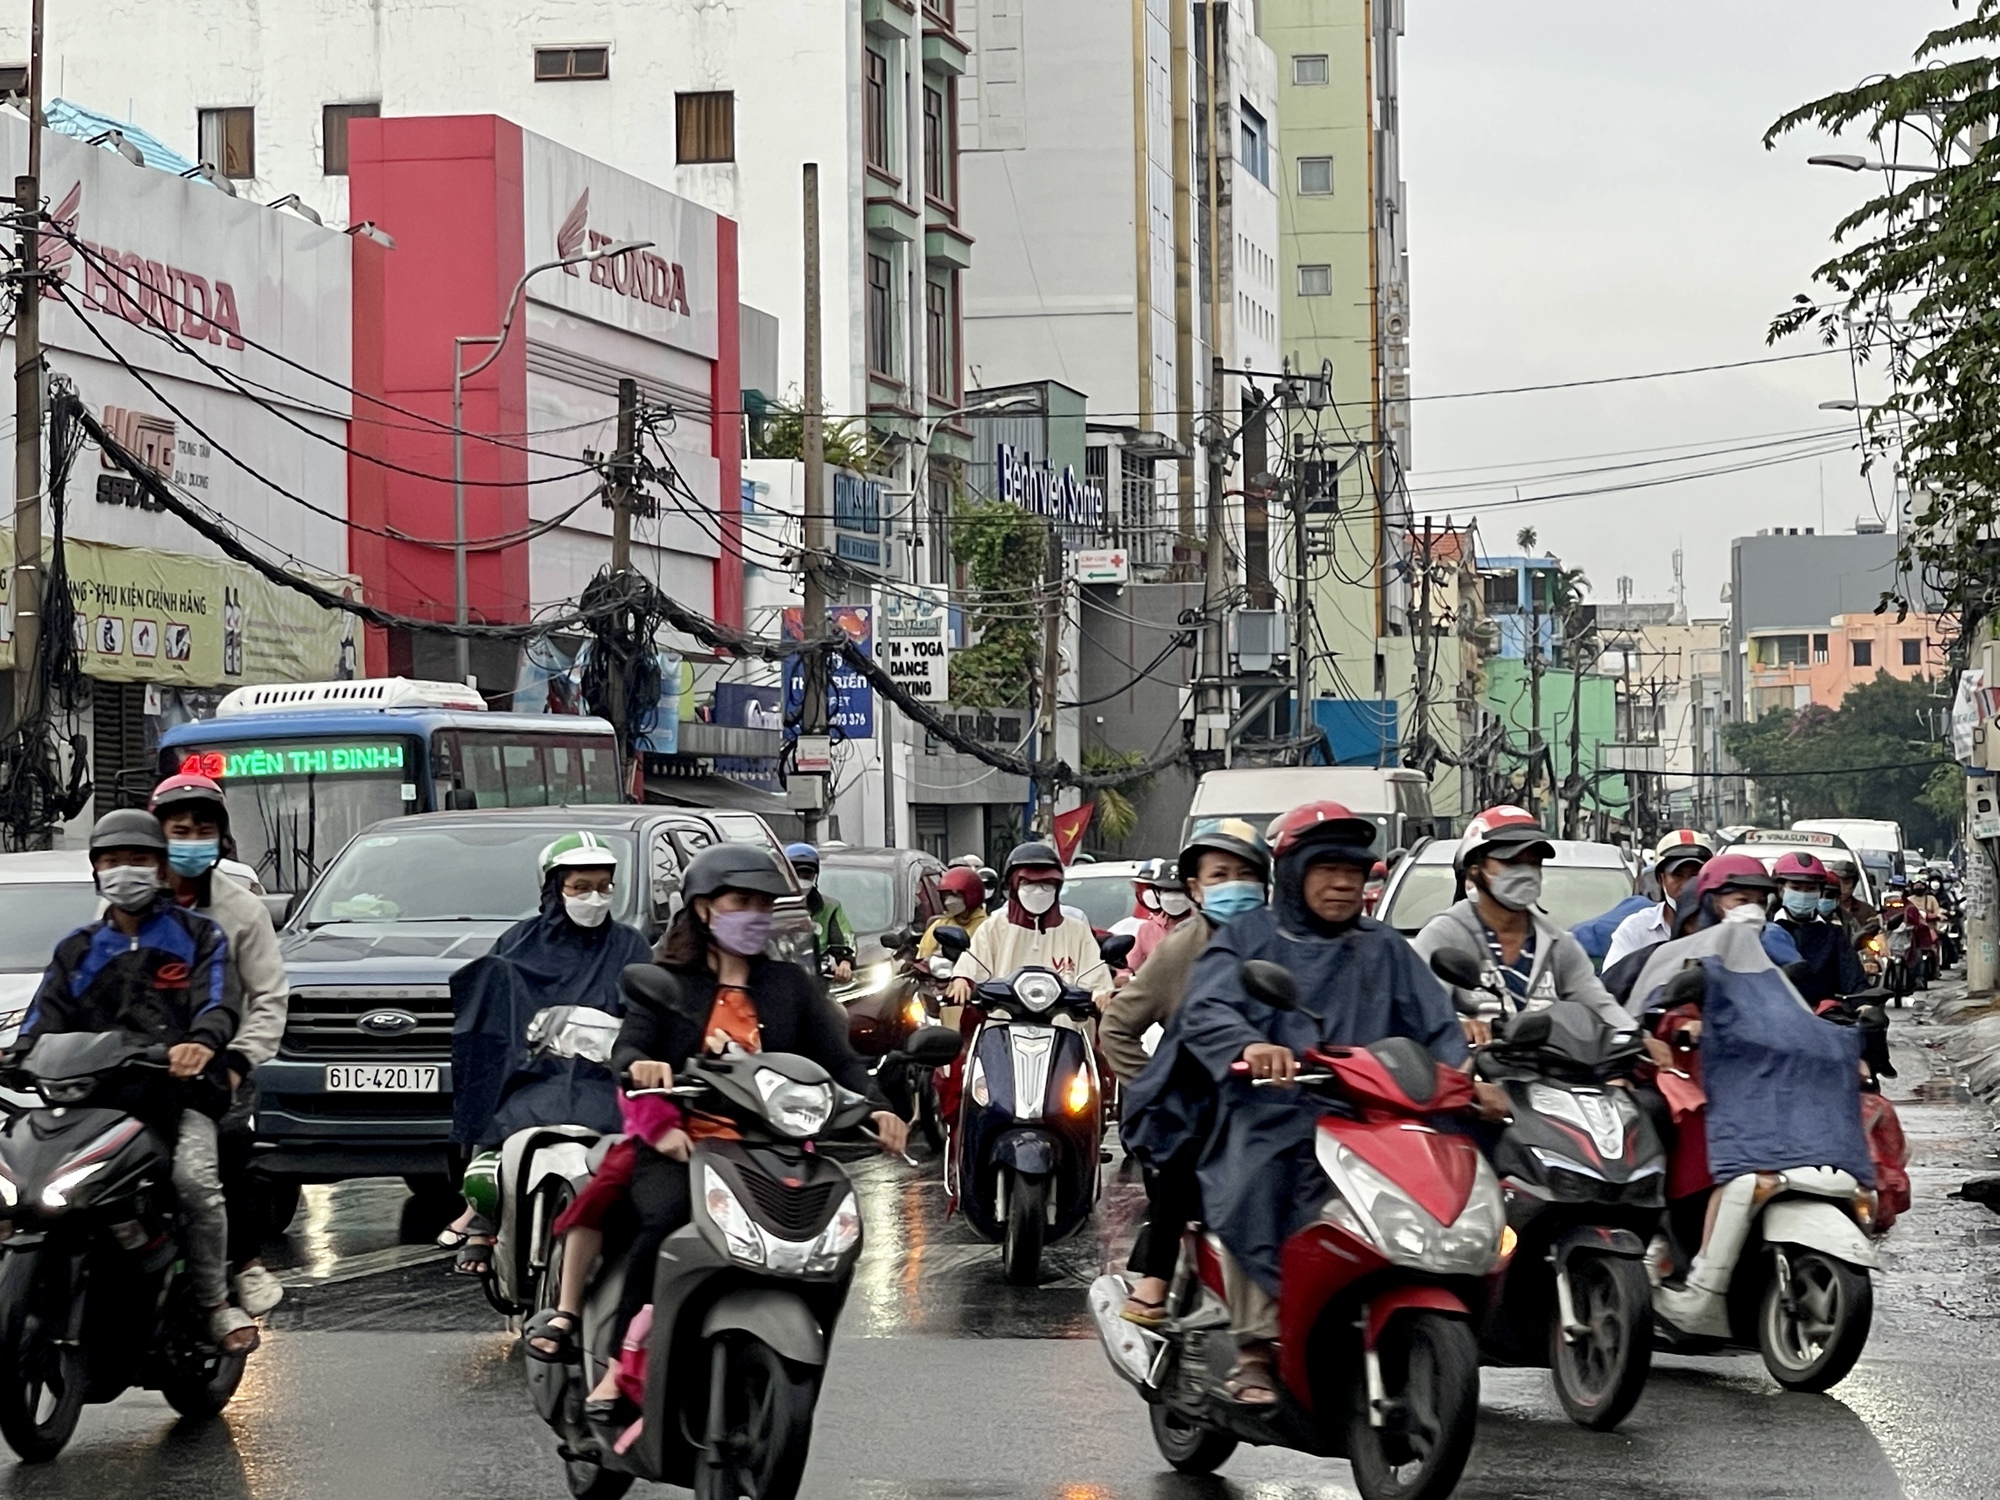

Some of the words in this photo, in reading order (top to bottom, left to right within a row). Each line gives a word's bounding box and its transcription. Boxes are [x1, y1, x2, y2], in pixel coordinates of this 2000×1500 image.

[588, 229, 691, 317] HONDA
[82, 240, 245, 352] HONDA
[1386, 283, 1406, 428] HOTEL
[146, 585, 178, 612] CHÍNH
[911, 642, 944, 656] YOGA
[890, 661, 929, 676] DANCE
[848, 712, 866, 726] 376
[180, 751, 227, 779] 43
[1766, 833, 1809, 842] VINASUN
[1810, 835, 1831, 844] TAXI
[330, 1068, 435, 1089] 61C-420.17
